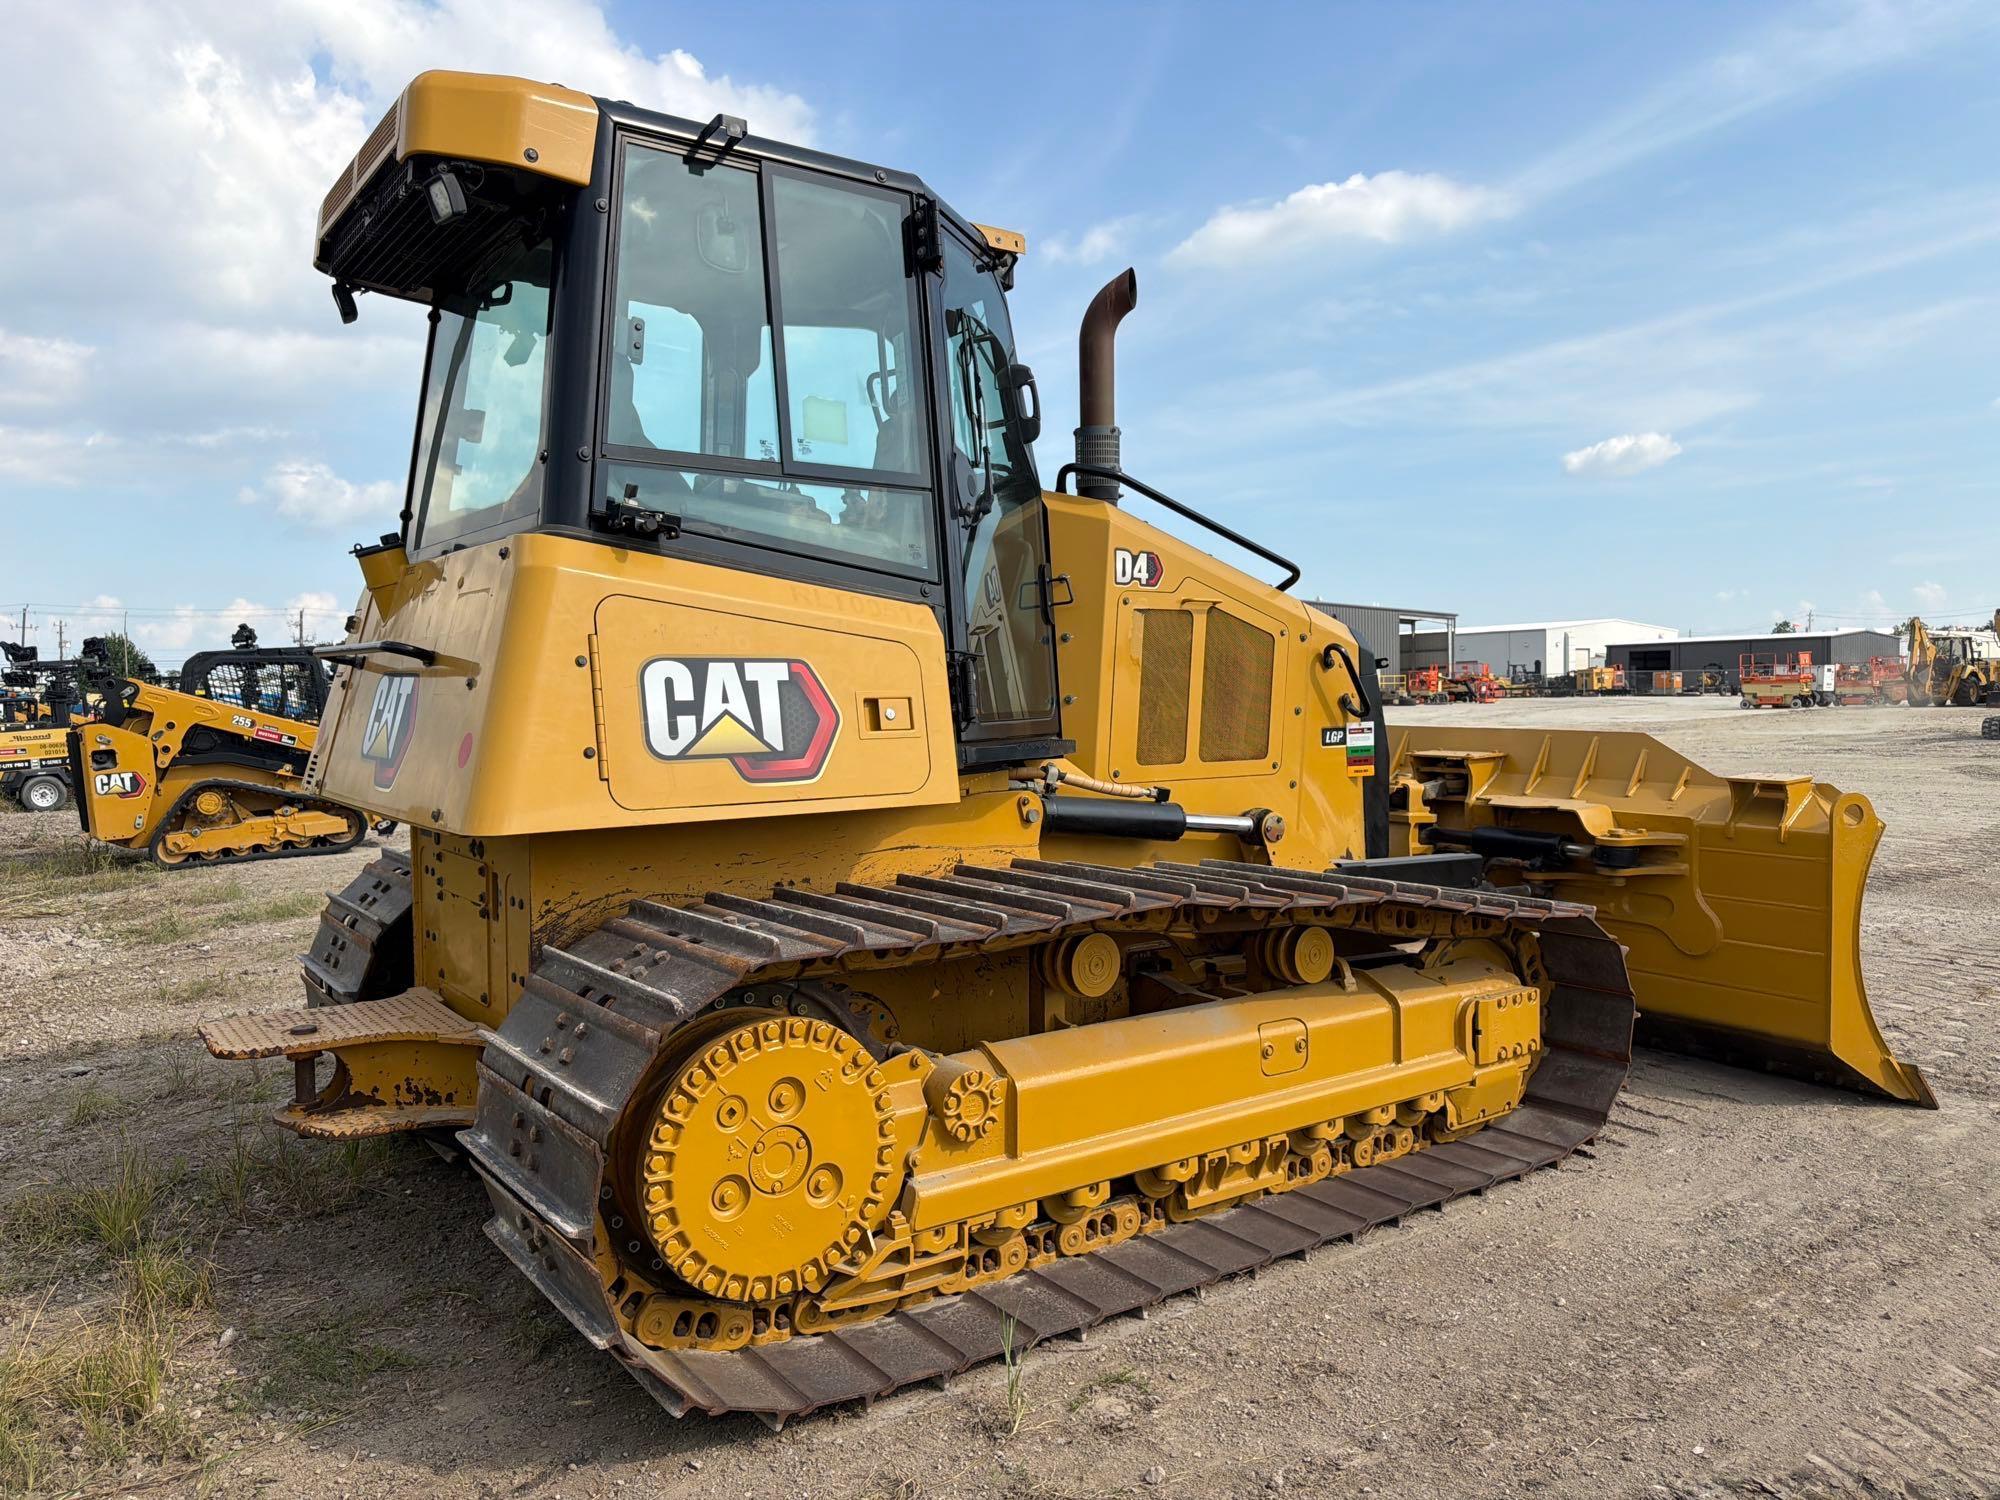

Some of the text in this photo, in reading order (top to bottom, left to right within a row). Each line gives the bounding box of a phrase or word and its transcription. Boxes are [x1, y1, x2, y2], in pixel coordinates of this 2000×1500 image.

[1115, 550, 1149, 585] D4
[232, 715, 252, 728] 255
[362, 676, 415, 760] CAT
[643, 660, 790, 757] CAT
[1325, 730, 1344, 744] LGP
[95, 772, 133, 795] CAT
